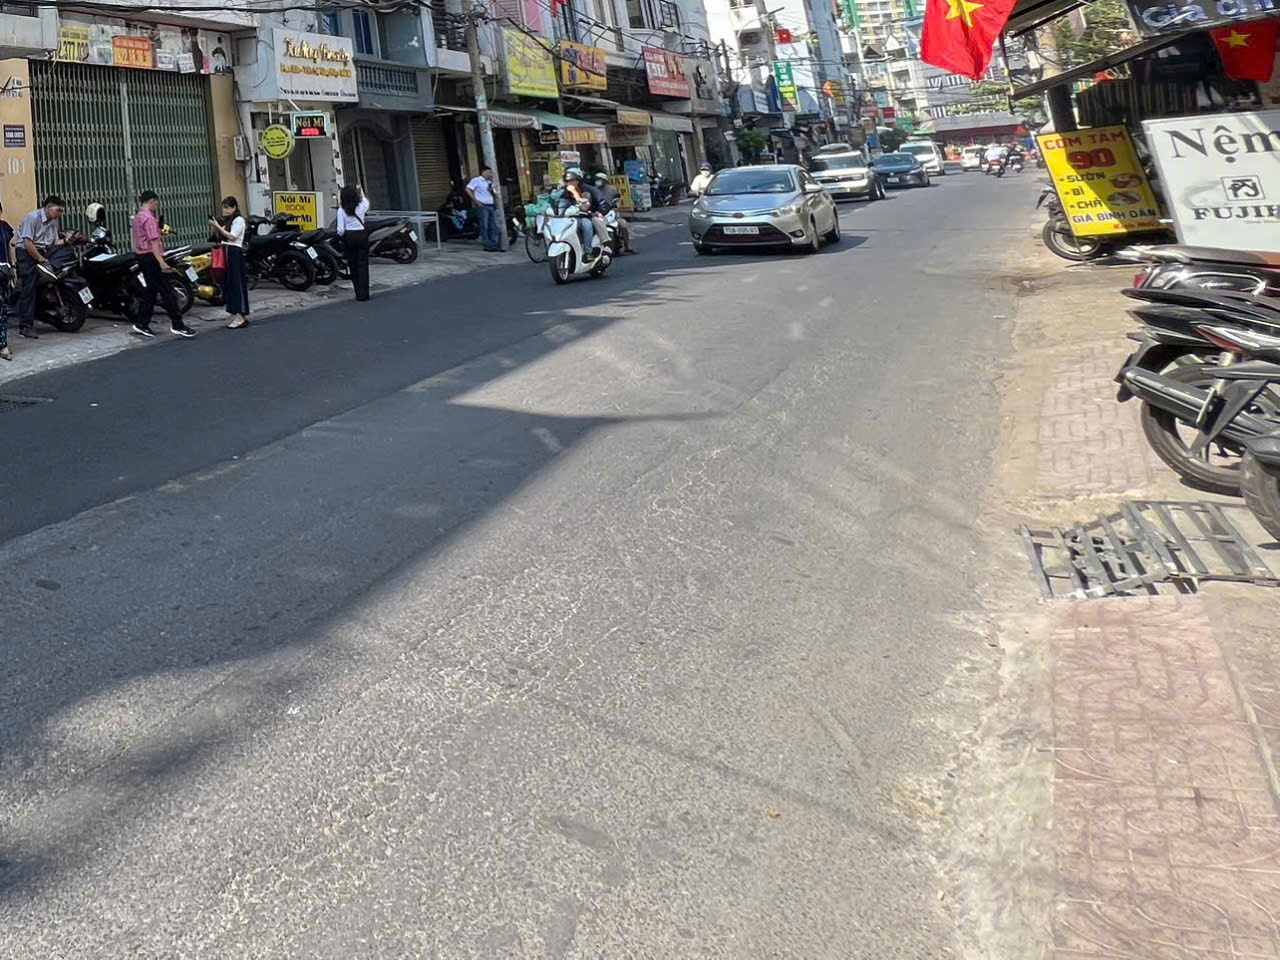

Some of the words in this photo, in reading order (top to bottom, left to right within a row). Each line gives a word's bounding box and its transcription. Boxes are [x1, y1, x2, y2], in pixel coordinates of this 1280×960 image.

[1162, 125, 1280, 163] Nệm
[7, 157, 25, 174] 101
[1068, 148, 1116, 170] 90
[299, 195, 311, 204] Mi
